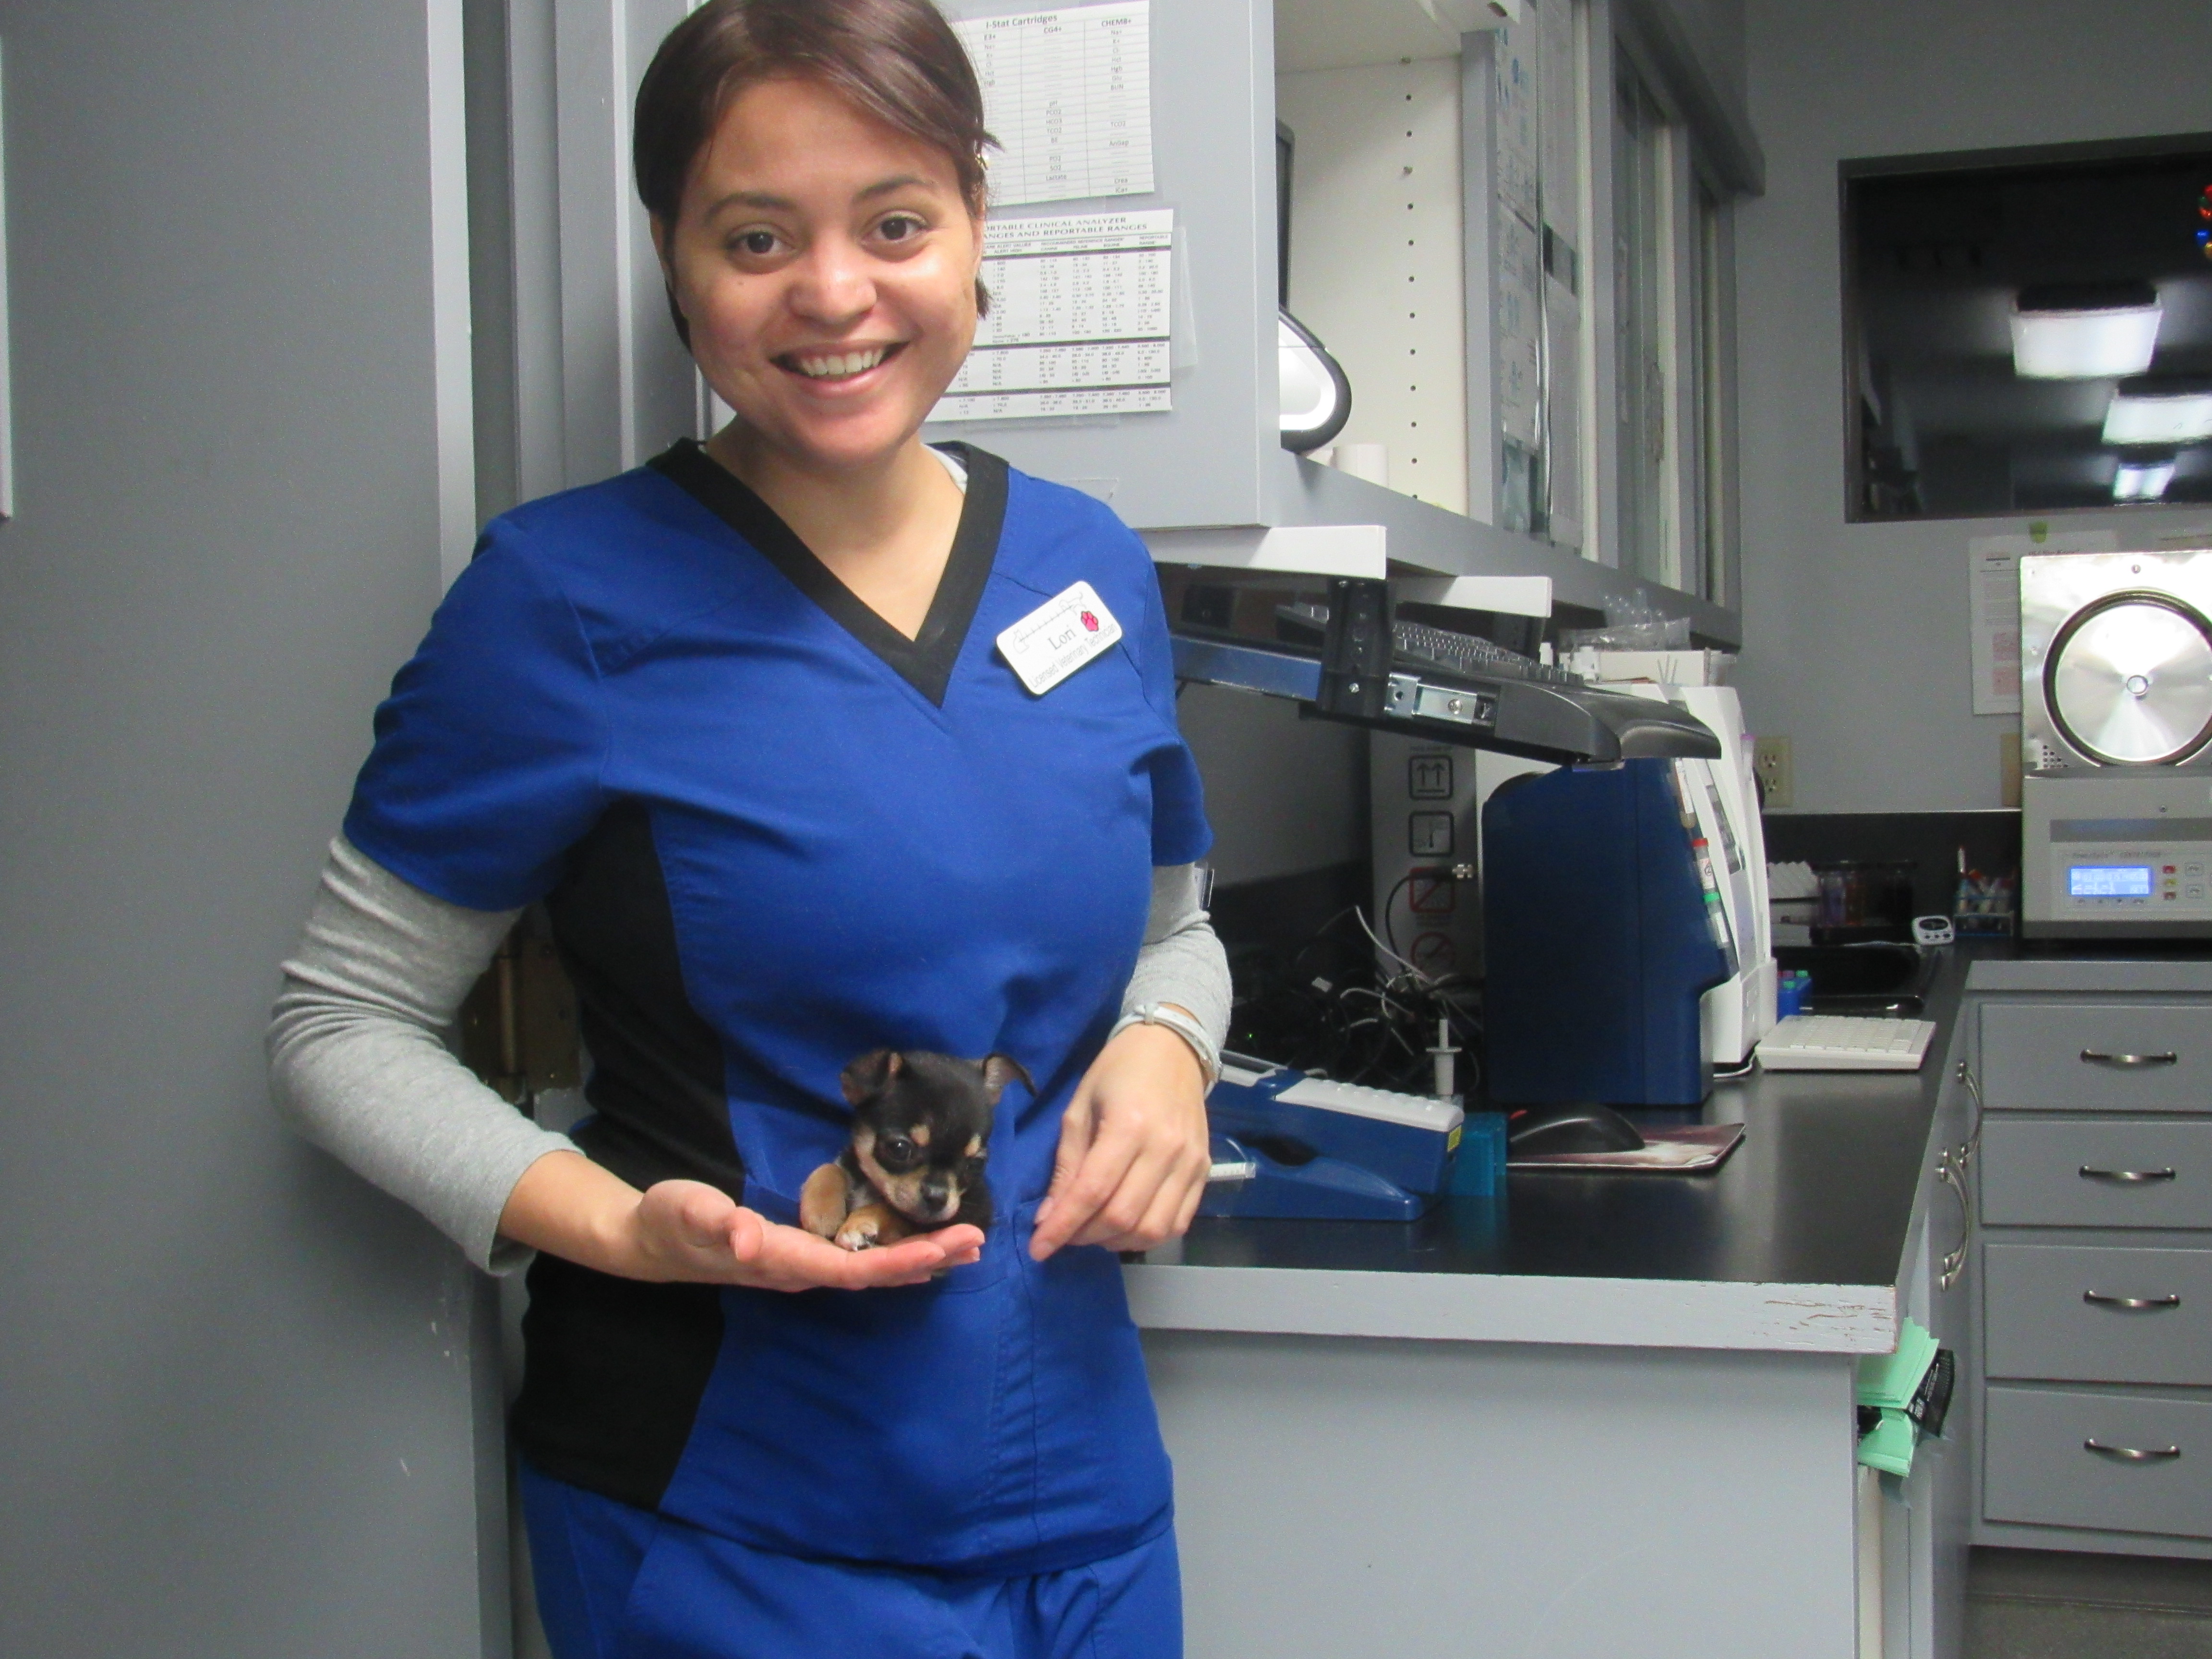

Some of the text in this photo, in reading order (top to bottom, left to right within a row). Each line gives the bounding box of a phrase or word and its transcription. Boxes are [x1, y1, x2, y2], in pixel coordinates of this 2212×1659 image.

[1012, 14, 1058, 26] Cartridges
[1077, 217, 1126, 226] ANALYZER
[1044, 226, 1104, 236] REPORTABLE
[1107, 224, 1147, 232] RANGES
[1047, 625, 1076, 649] Lori
[1028, 623, 1118, 688] Licensed Veterinary Technician
